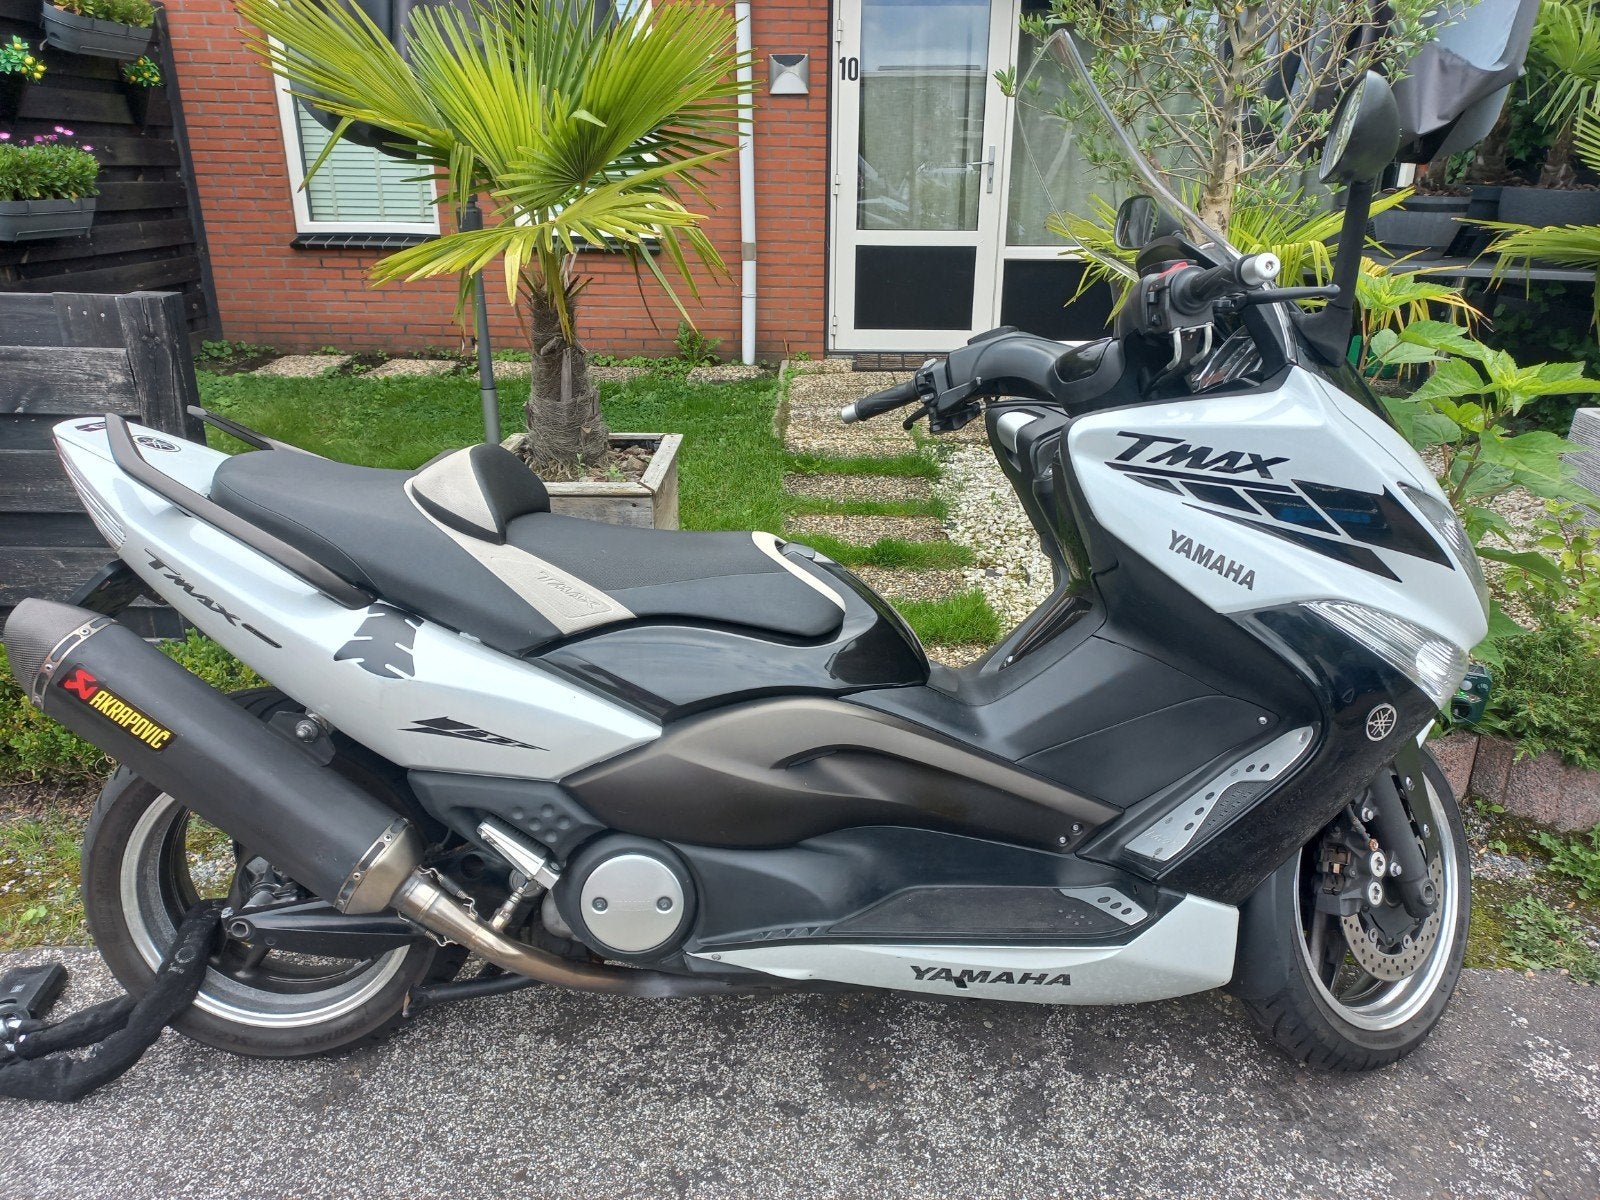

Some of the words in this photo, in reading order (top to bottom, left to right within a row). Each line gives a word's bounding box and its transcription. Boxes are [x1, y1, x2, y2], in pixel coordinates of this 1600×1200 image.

[839, 56, 859, 81] 10
[1114, 430, 1290, 479] TMAX
[1168, 529, 1256, 591] YAMAHA
[910, 965, 1071, 986] YAMAHA
